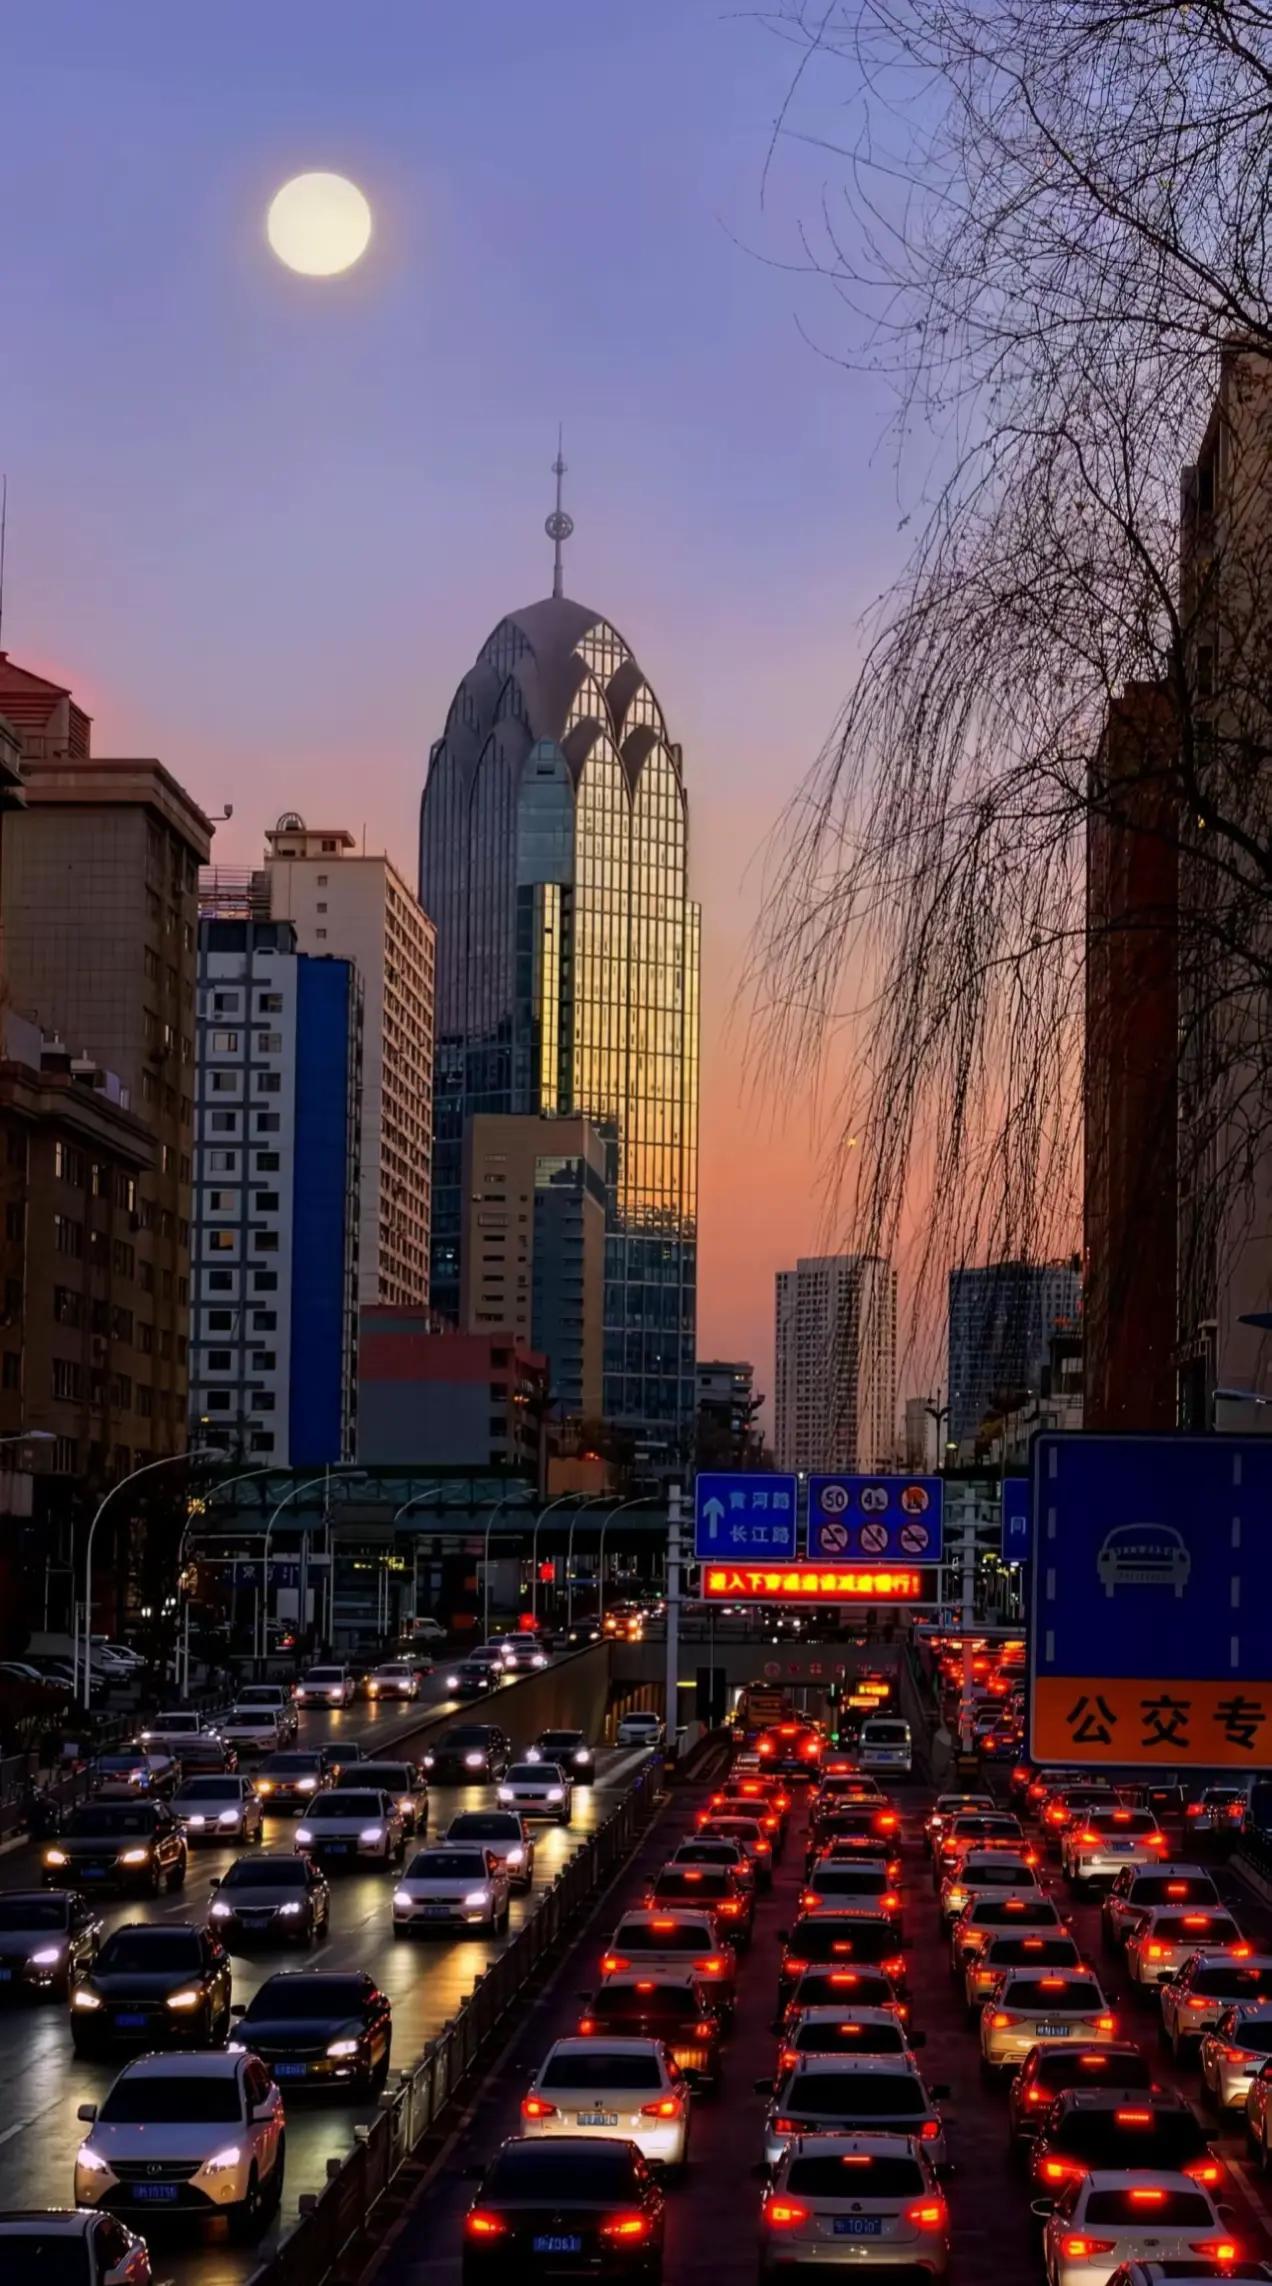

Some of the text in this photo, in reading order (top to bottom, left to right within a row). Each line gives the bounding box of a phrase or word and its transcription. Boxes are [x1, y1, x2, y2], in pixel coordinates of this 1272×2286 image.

[825, 1491, 844, 1508] 50
[729, 1523, 790, 1544] 长江路
[1066, 1695, 1265, 1749] 公交专
